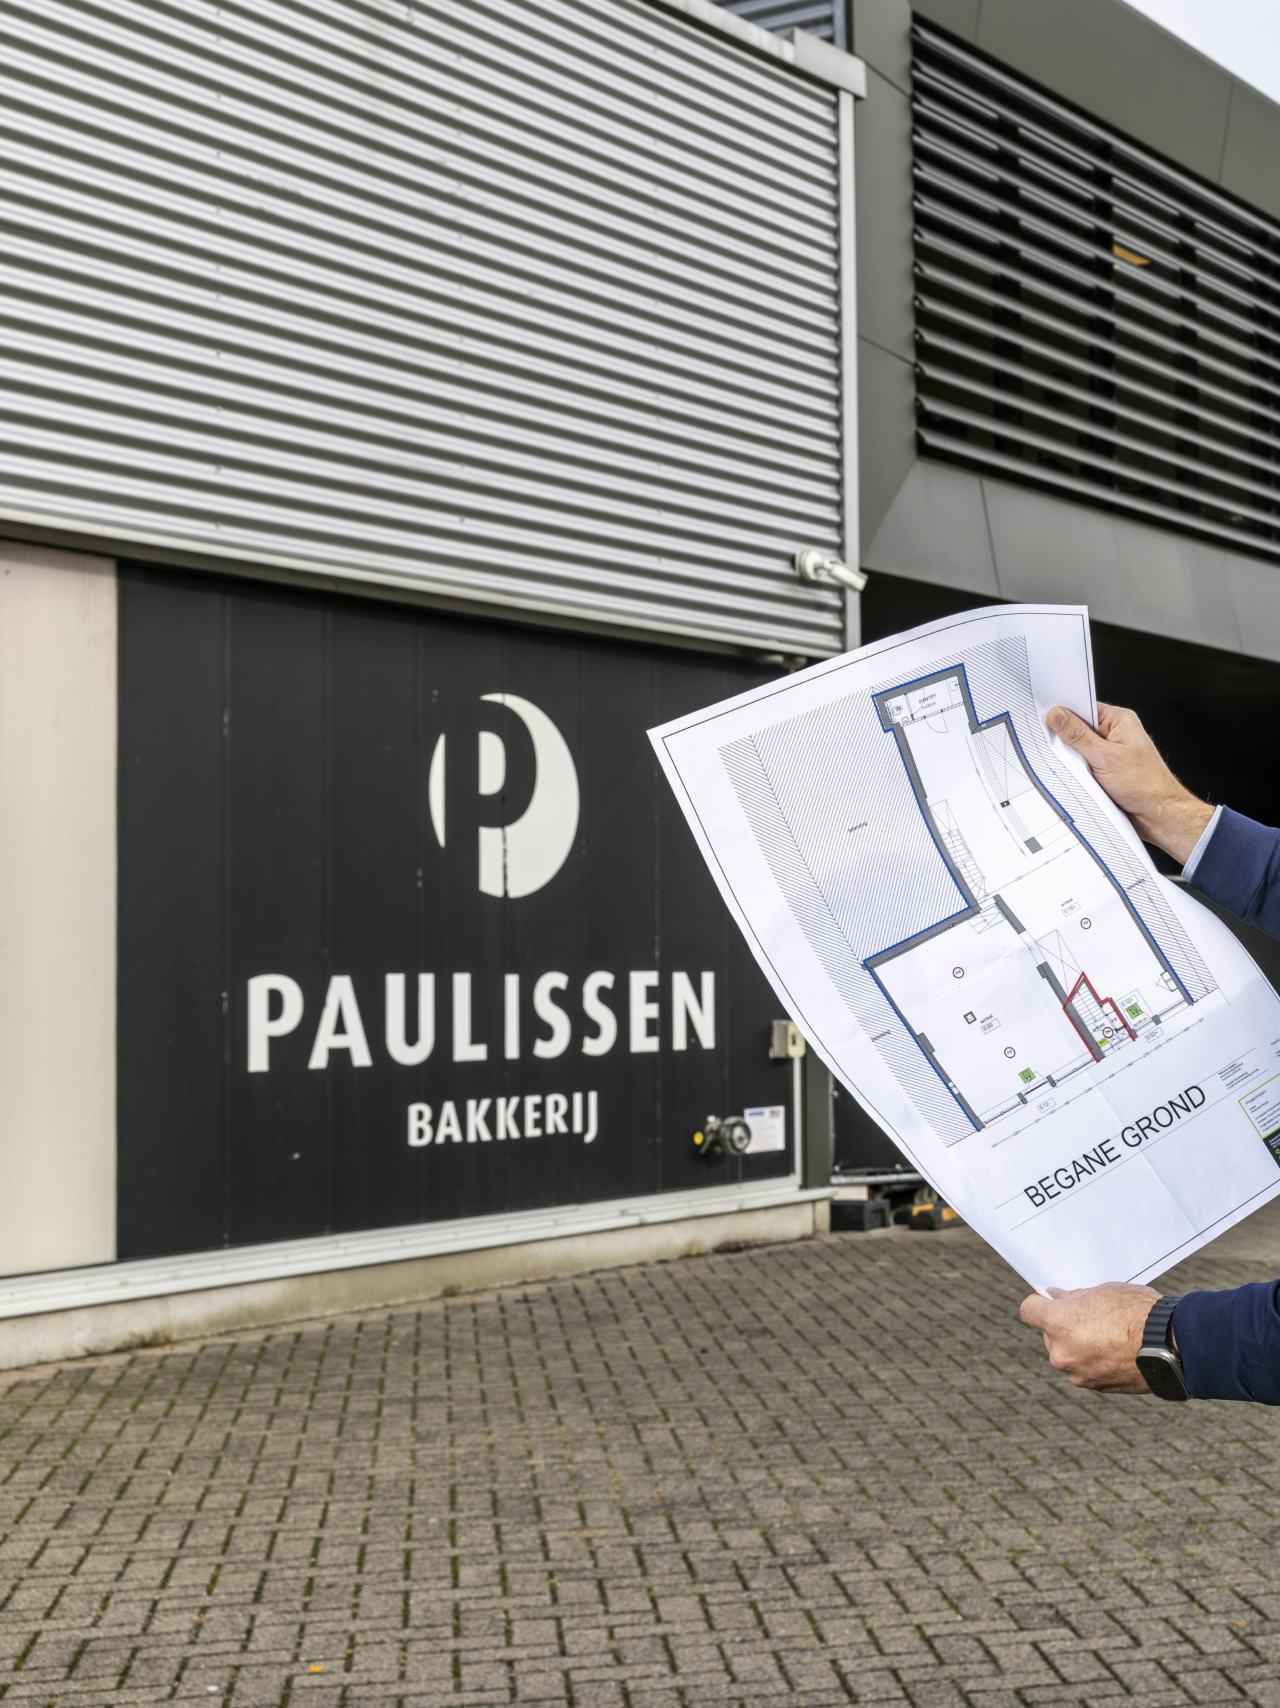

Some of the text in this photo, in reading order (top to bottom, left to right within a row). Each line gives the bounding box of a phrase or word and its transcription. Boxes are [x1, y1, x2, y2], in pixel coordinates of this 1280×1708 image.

[246, 968, 717, 1073] PAULISSEN
[406, 1089, 599, 1148] BAKKERIJ
[1023, 1138, 1122, 1208] BEGANE
[1121, 1085, 1206, 1148] GROND
